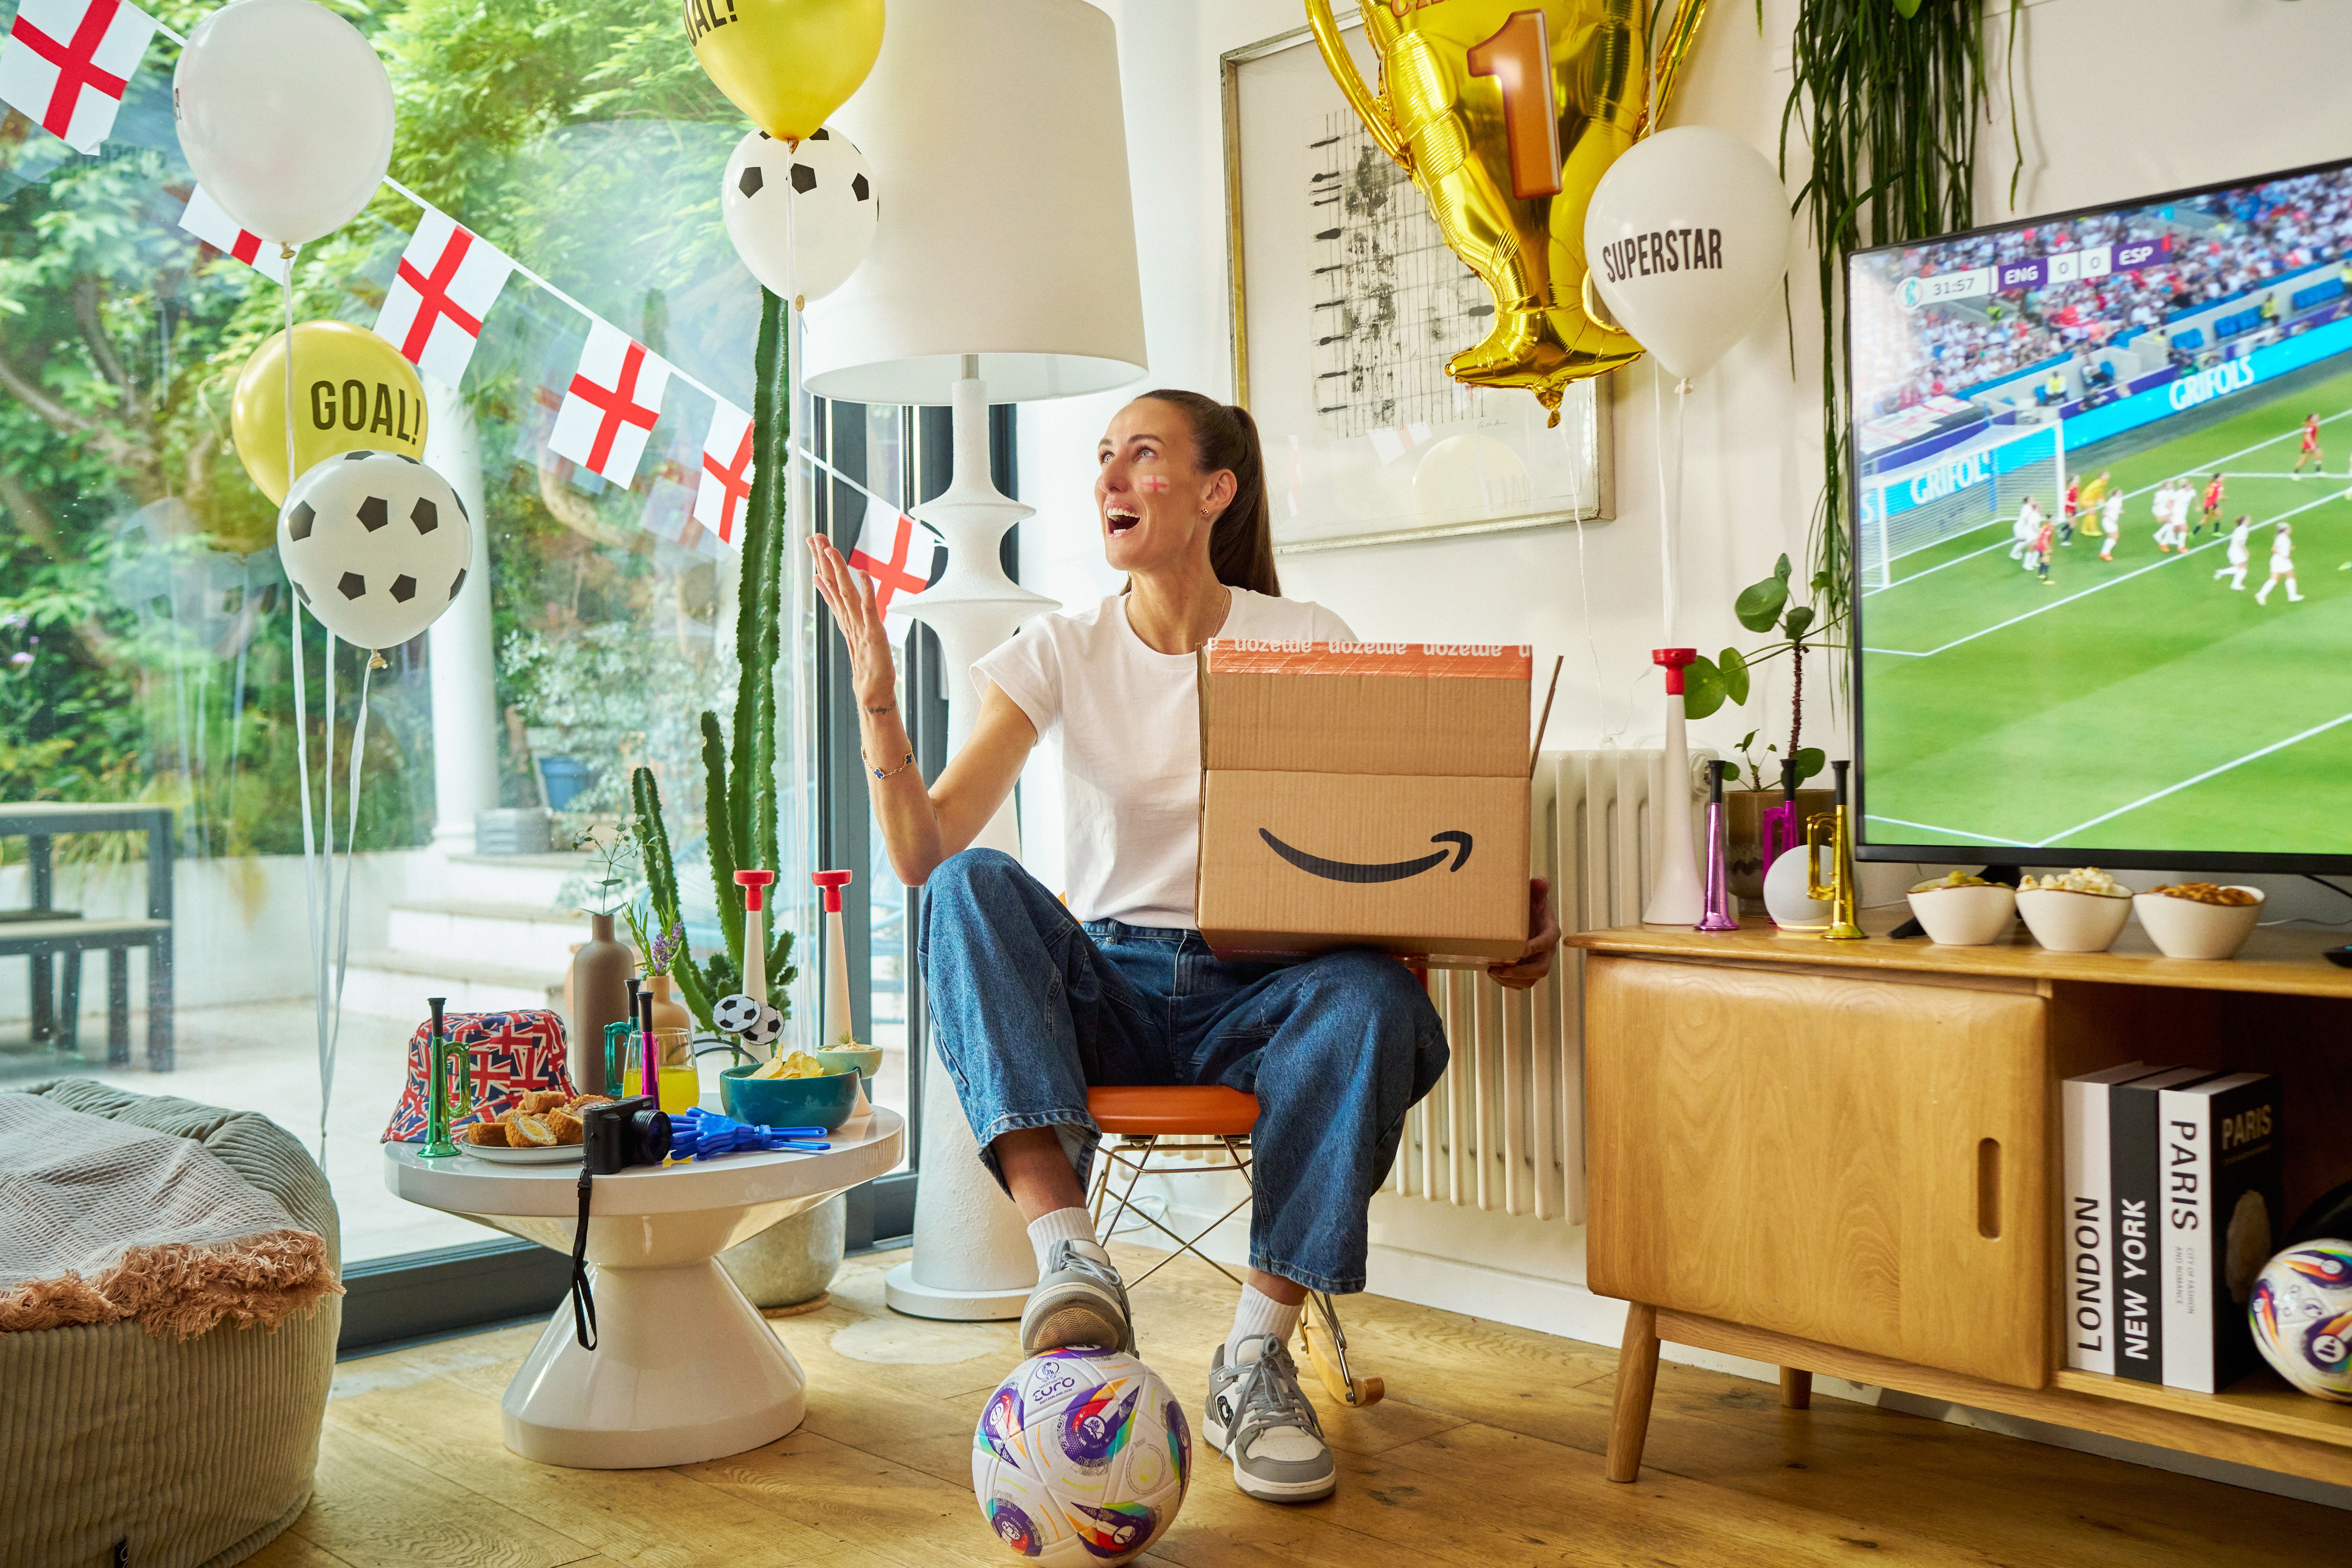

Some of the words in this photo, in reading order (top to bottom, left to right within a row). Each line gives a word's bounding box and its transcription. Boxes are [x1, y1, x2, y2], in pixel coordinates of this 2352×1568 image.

[1466, 9, 1562, 200] 1
[1603, 228, 1723, 283] SUPERSTAR
[1934, 278, 1974, 295] 31:57
[2004, 265, 2039, 285] ENG
[2058, 262, 2069, 275] 0
[2090, 256, 2101, 269] 0
[2119, 245, 2154, 266] ESP
[2169, 355, 2255, 410] GRIFOLS
[311, 379, 420, 445] GOAL!
[1235, 638, 1312, 653] amazon
[1329, 641, 1407, 655] amazon
[1423, 644, 1503, 657] amazon
[2222, 1104, 2272, 1150] PARIS
[2171, 1121, 2198, 1230] PARIS
[2122, 1198, 2147, 1279] YORK
[2074, 1196, 2102, 1352] LONDON
[2123, 1288, 2149, 1360] NEW
[1040, 1391, 1064, 1405] SWITZERLAND
